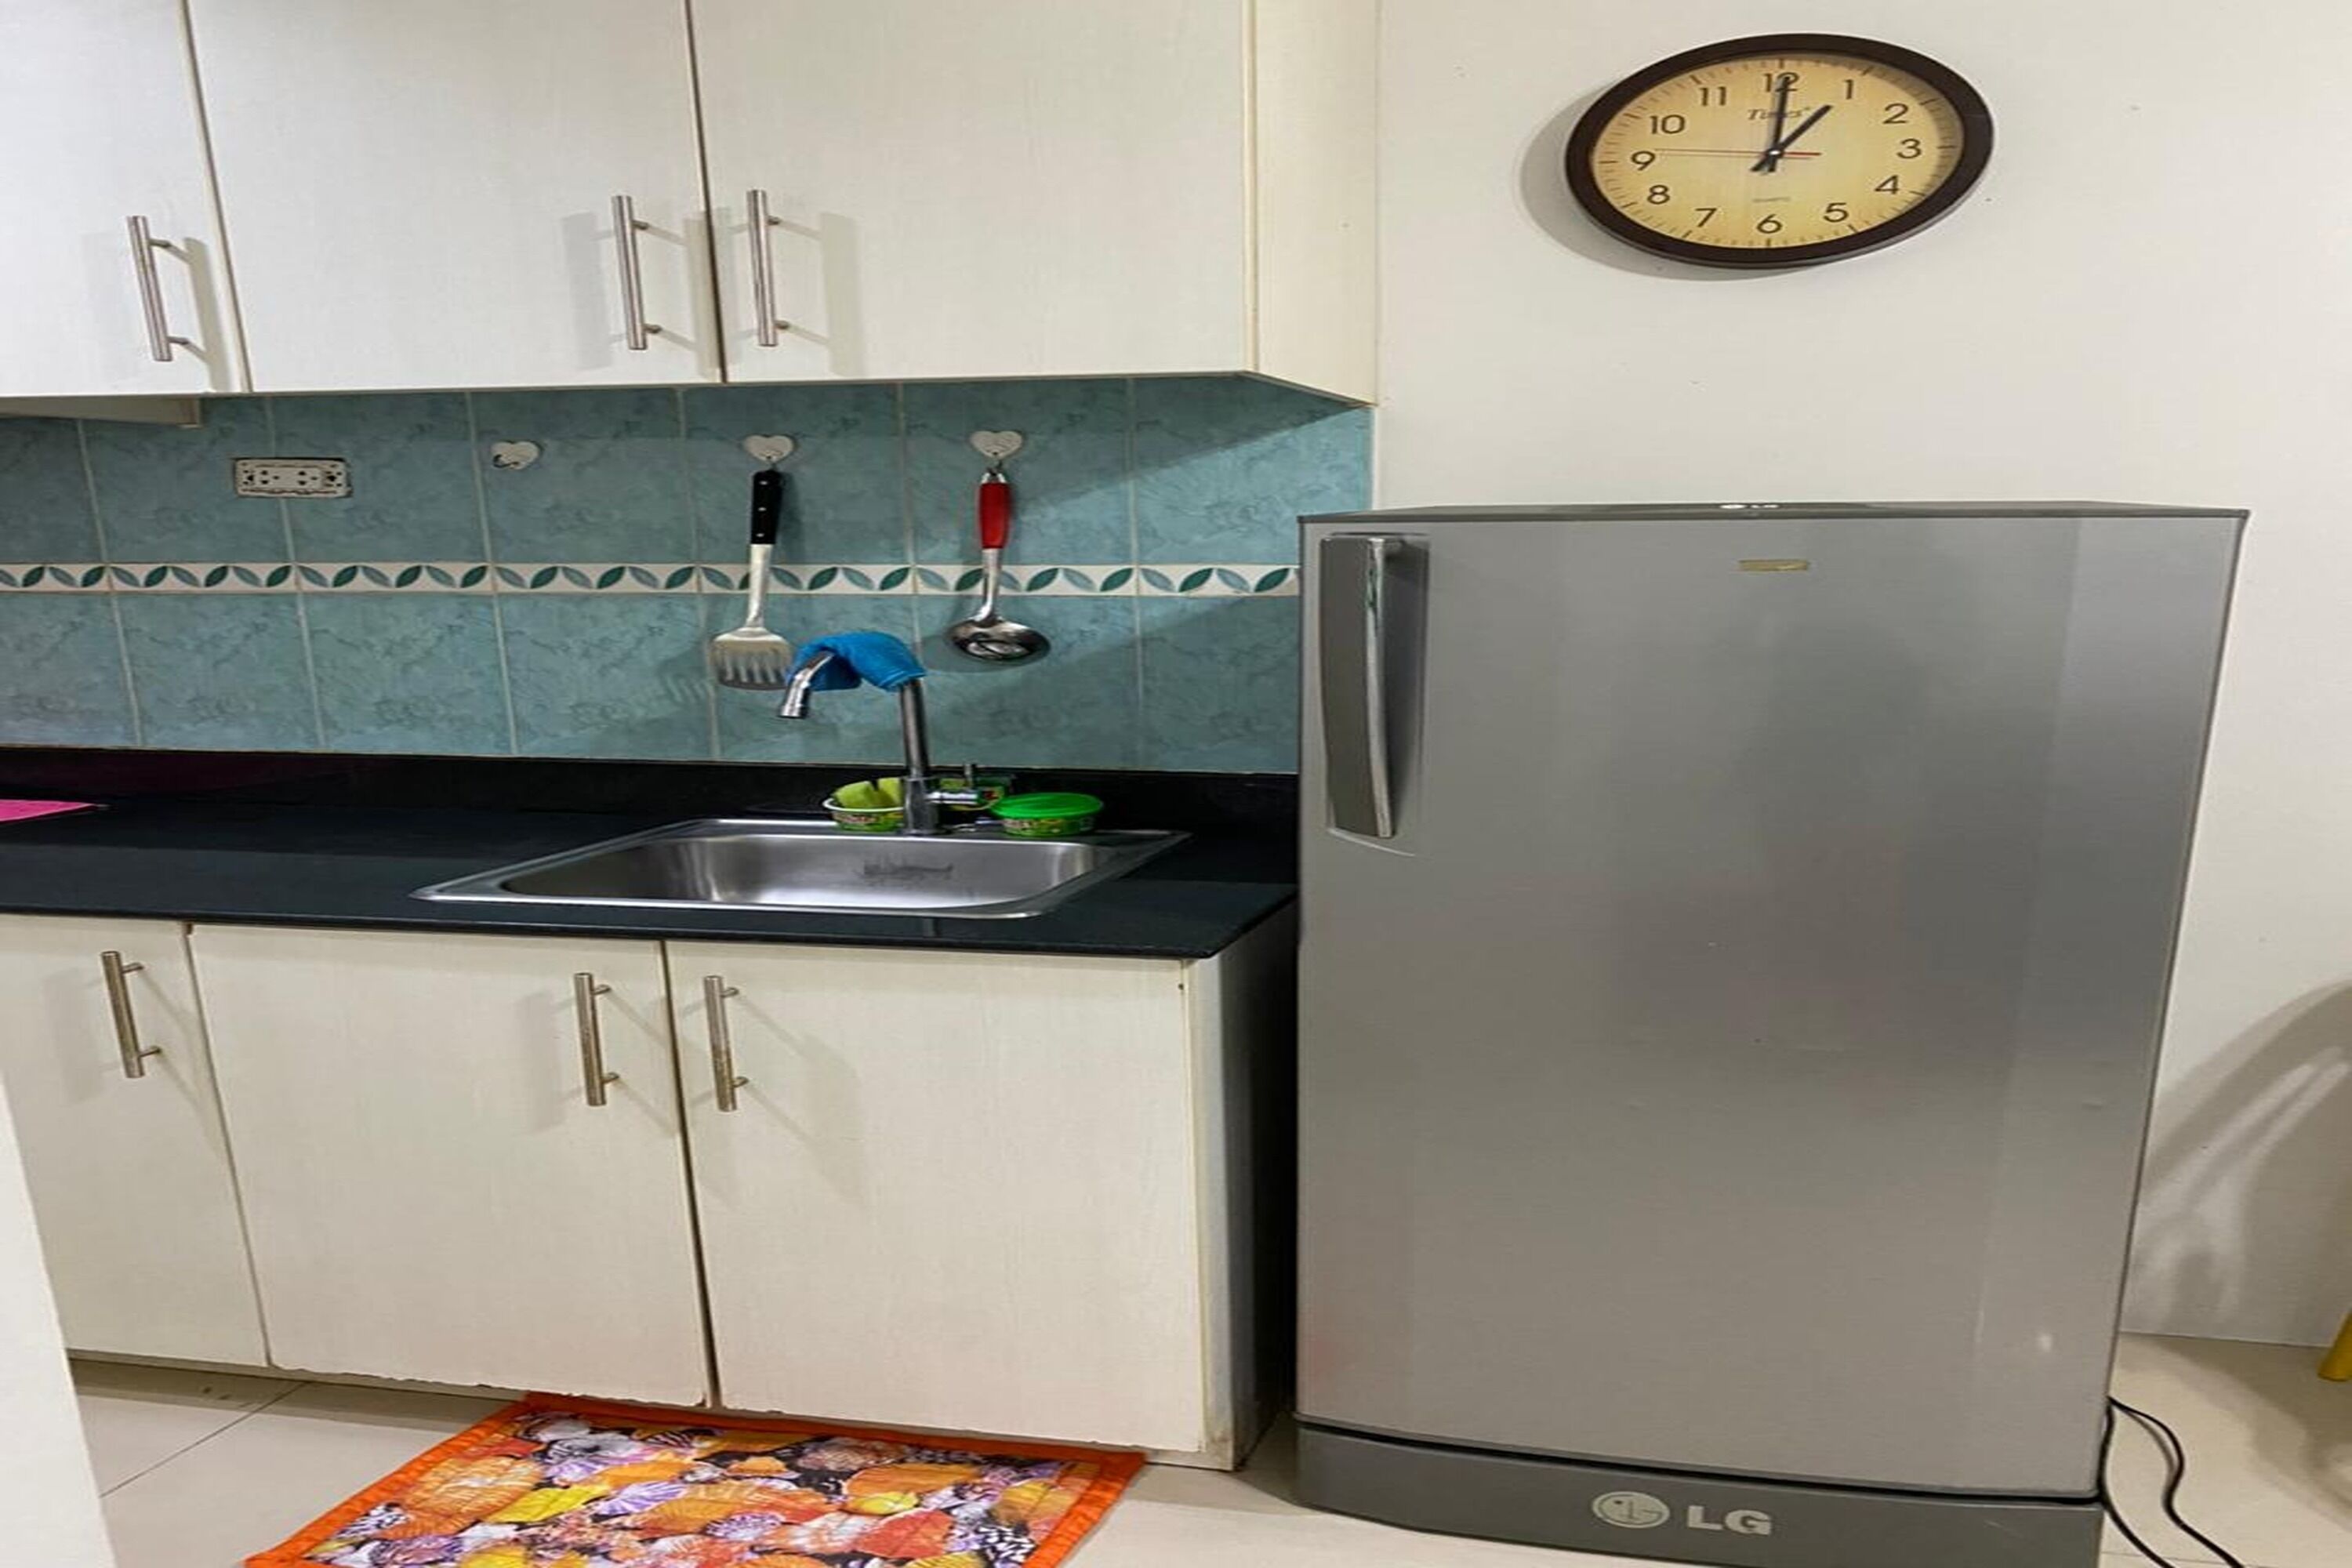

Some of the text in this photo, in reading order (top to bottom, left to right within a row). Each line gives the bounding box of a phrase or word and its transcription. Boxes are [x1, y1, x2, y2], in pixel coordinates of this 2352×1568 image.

[1763, 71, 1800, 93] 12
[1843, 79, 1853, 100] 1
[1699, 86, 1727, 107] 11
[1649, 114, 1686, 135] 10
[1882, 103, 1909, 125] 2
[1896, 138, 1922, 160] 3
[1630, 150, 1657, 171] 9
[1646, 184, 1671, 205] 8
[1874, 174, 1900, 195] 4
[1695, 207, 1718, 228] 7
[1823, 201, 1849, 223] 5
[1756, 213, 1784, 234] 6
[1687, 1504, 1772, 1535] LG
